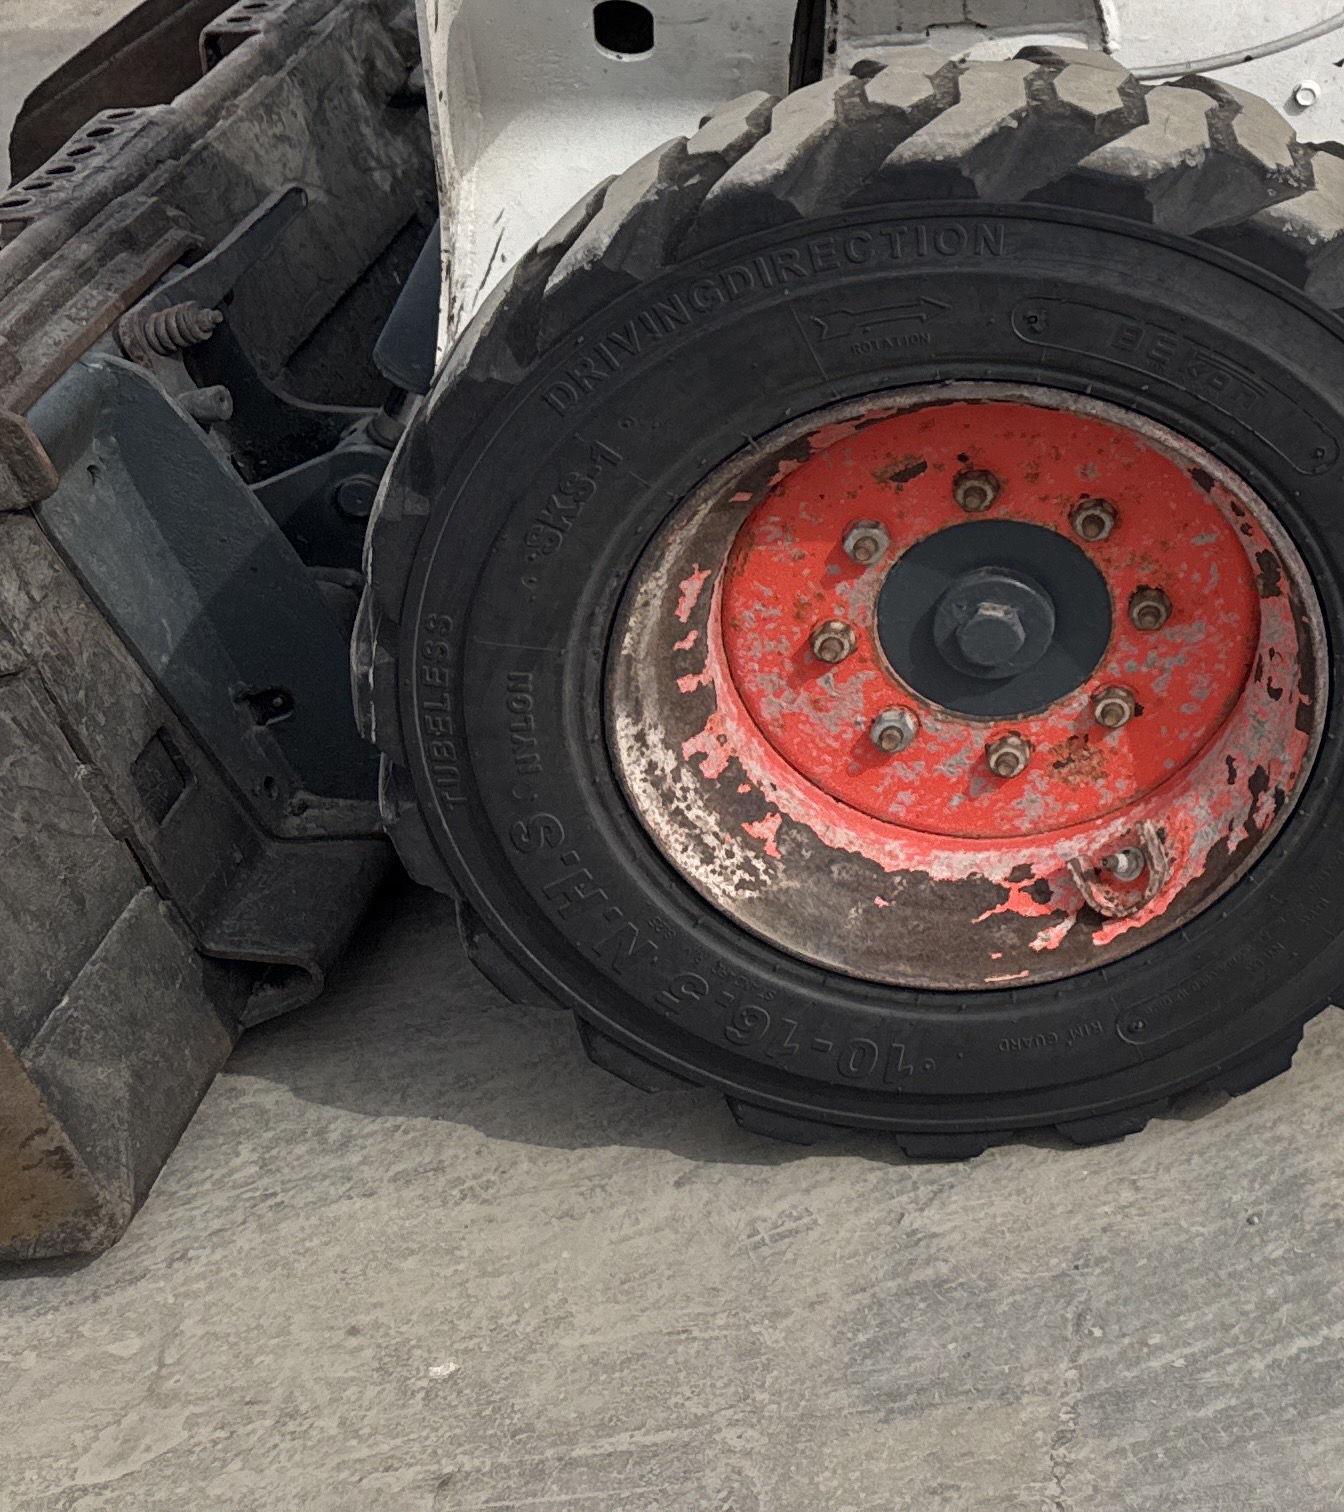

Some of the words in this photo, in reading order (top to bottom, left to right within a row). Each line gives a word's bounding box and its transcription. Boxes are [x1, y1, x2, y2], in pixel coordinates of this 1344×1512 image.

[850, 331, 932, 356] ROTATION
[422, 612, 468, 811] TUBELESS
[507, 671, 543, 774] NYLON
[1070, 1020, 1103, 1040] RIM
